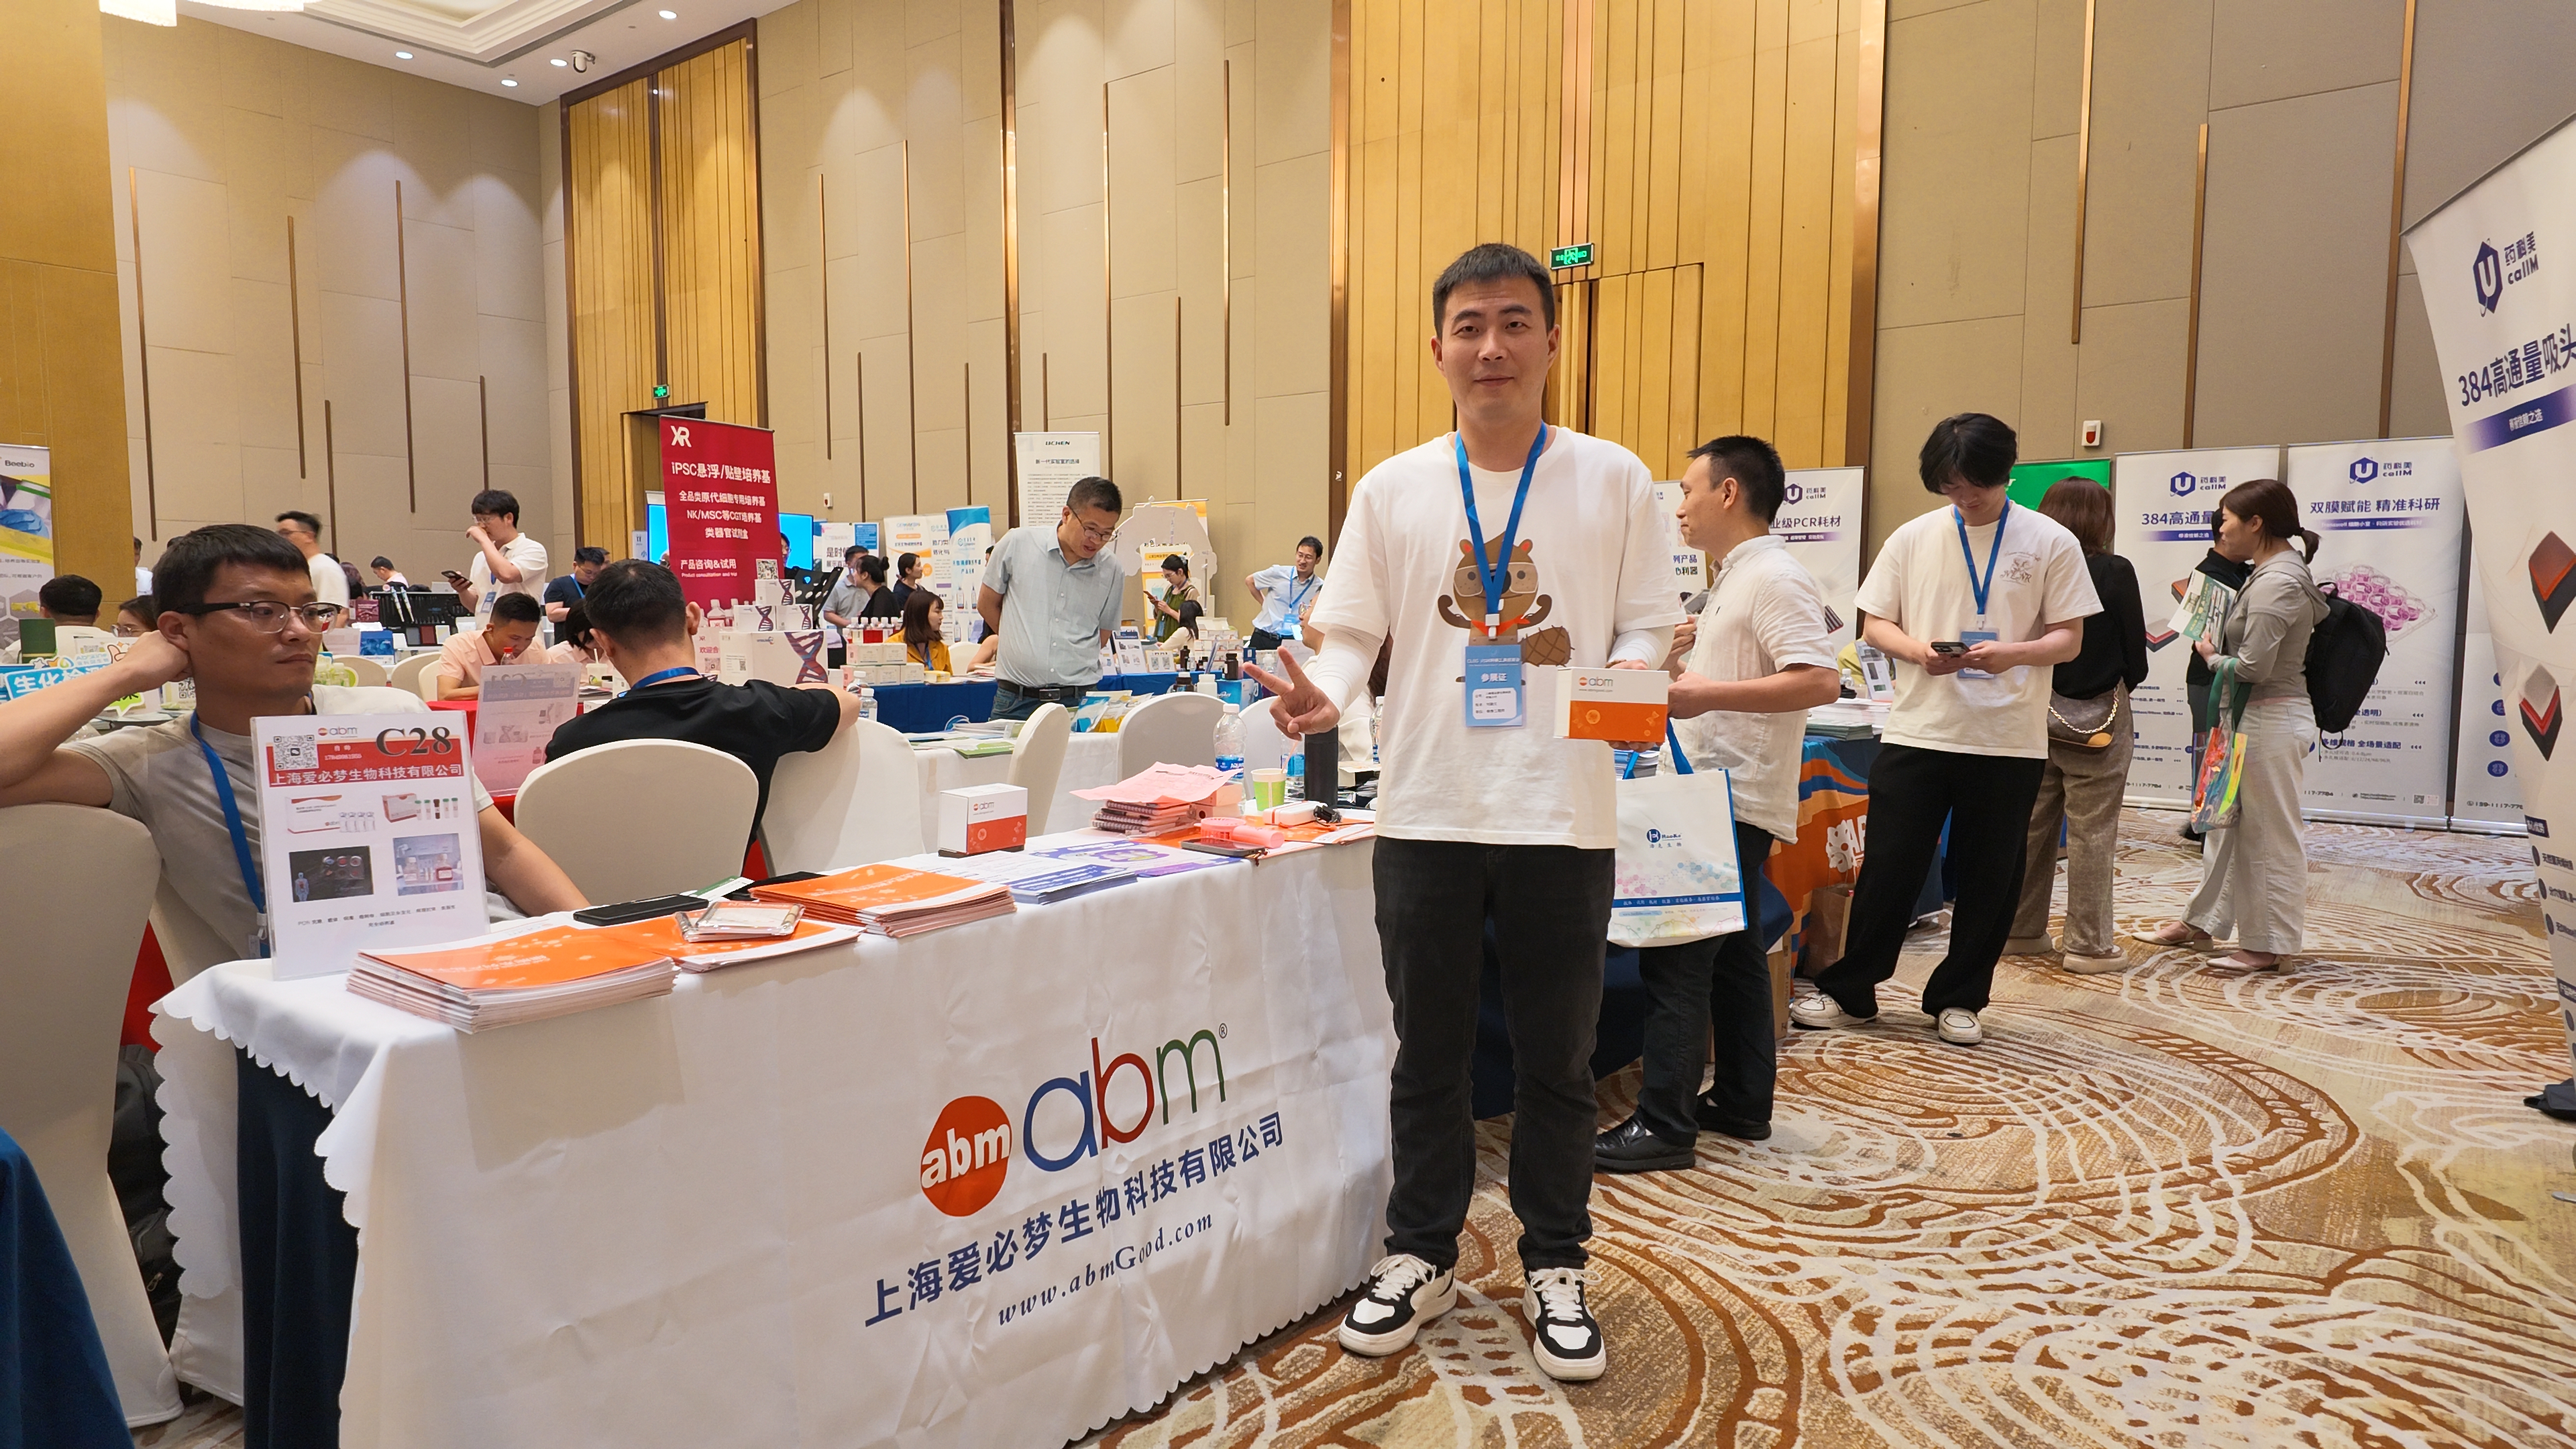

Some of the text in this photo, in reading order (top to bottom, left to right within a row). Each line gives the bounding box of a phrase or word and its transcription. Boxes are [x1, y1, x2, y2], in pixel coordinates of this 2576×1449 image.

[2504, 231, 2536, 266] 药科美
[2508, 254, 2539, 285] callM
[2458, 323, 2576, 407] 384高通量吸头
[671, 425, 692, 447] XR
[672, 462, 771, 484] iPSC悬浮/贴壁培养基
[679, 490, 765, 506] 全品类原代细胞专用培养基
[2310, 498, 2440, 514] 双膜赋能 精准科研
[687, 510, 762, 523] NK/MSC等CGT培养基
[2141, 511, 2213, 525] 384高通量
[681, 559, 737, 570] 产品咨询&试用
[1589, 677, 1613, 686] abm
[329, 727, 358, 735] abm
[376, 727, 452, 757] C28
[2357, 739, 2402, 749] 全场景适配
[271, 764, 462, 786] 上海爱必梦生物科技有限公司
[921, 1124, 1010, 1189] abm
[865, 1112, 1283, 1328] 上海爱必梦生物科技有限公司
[998, 1214, 1213, 1326] www.abmGood.com
